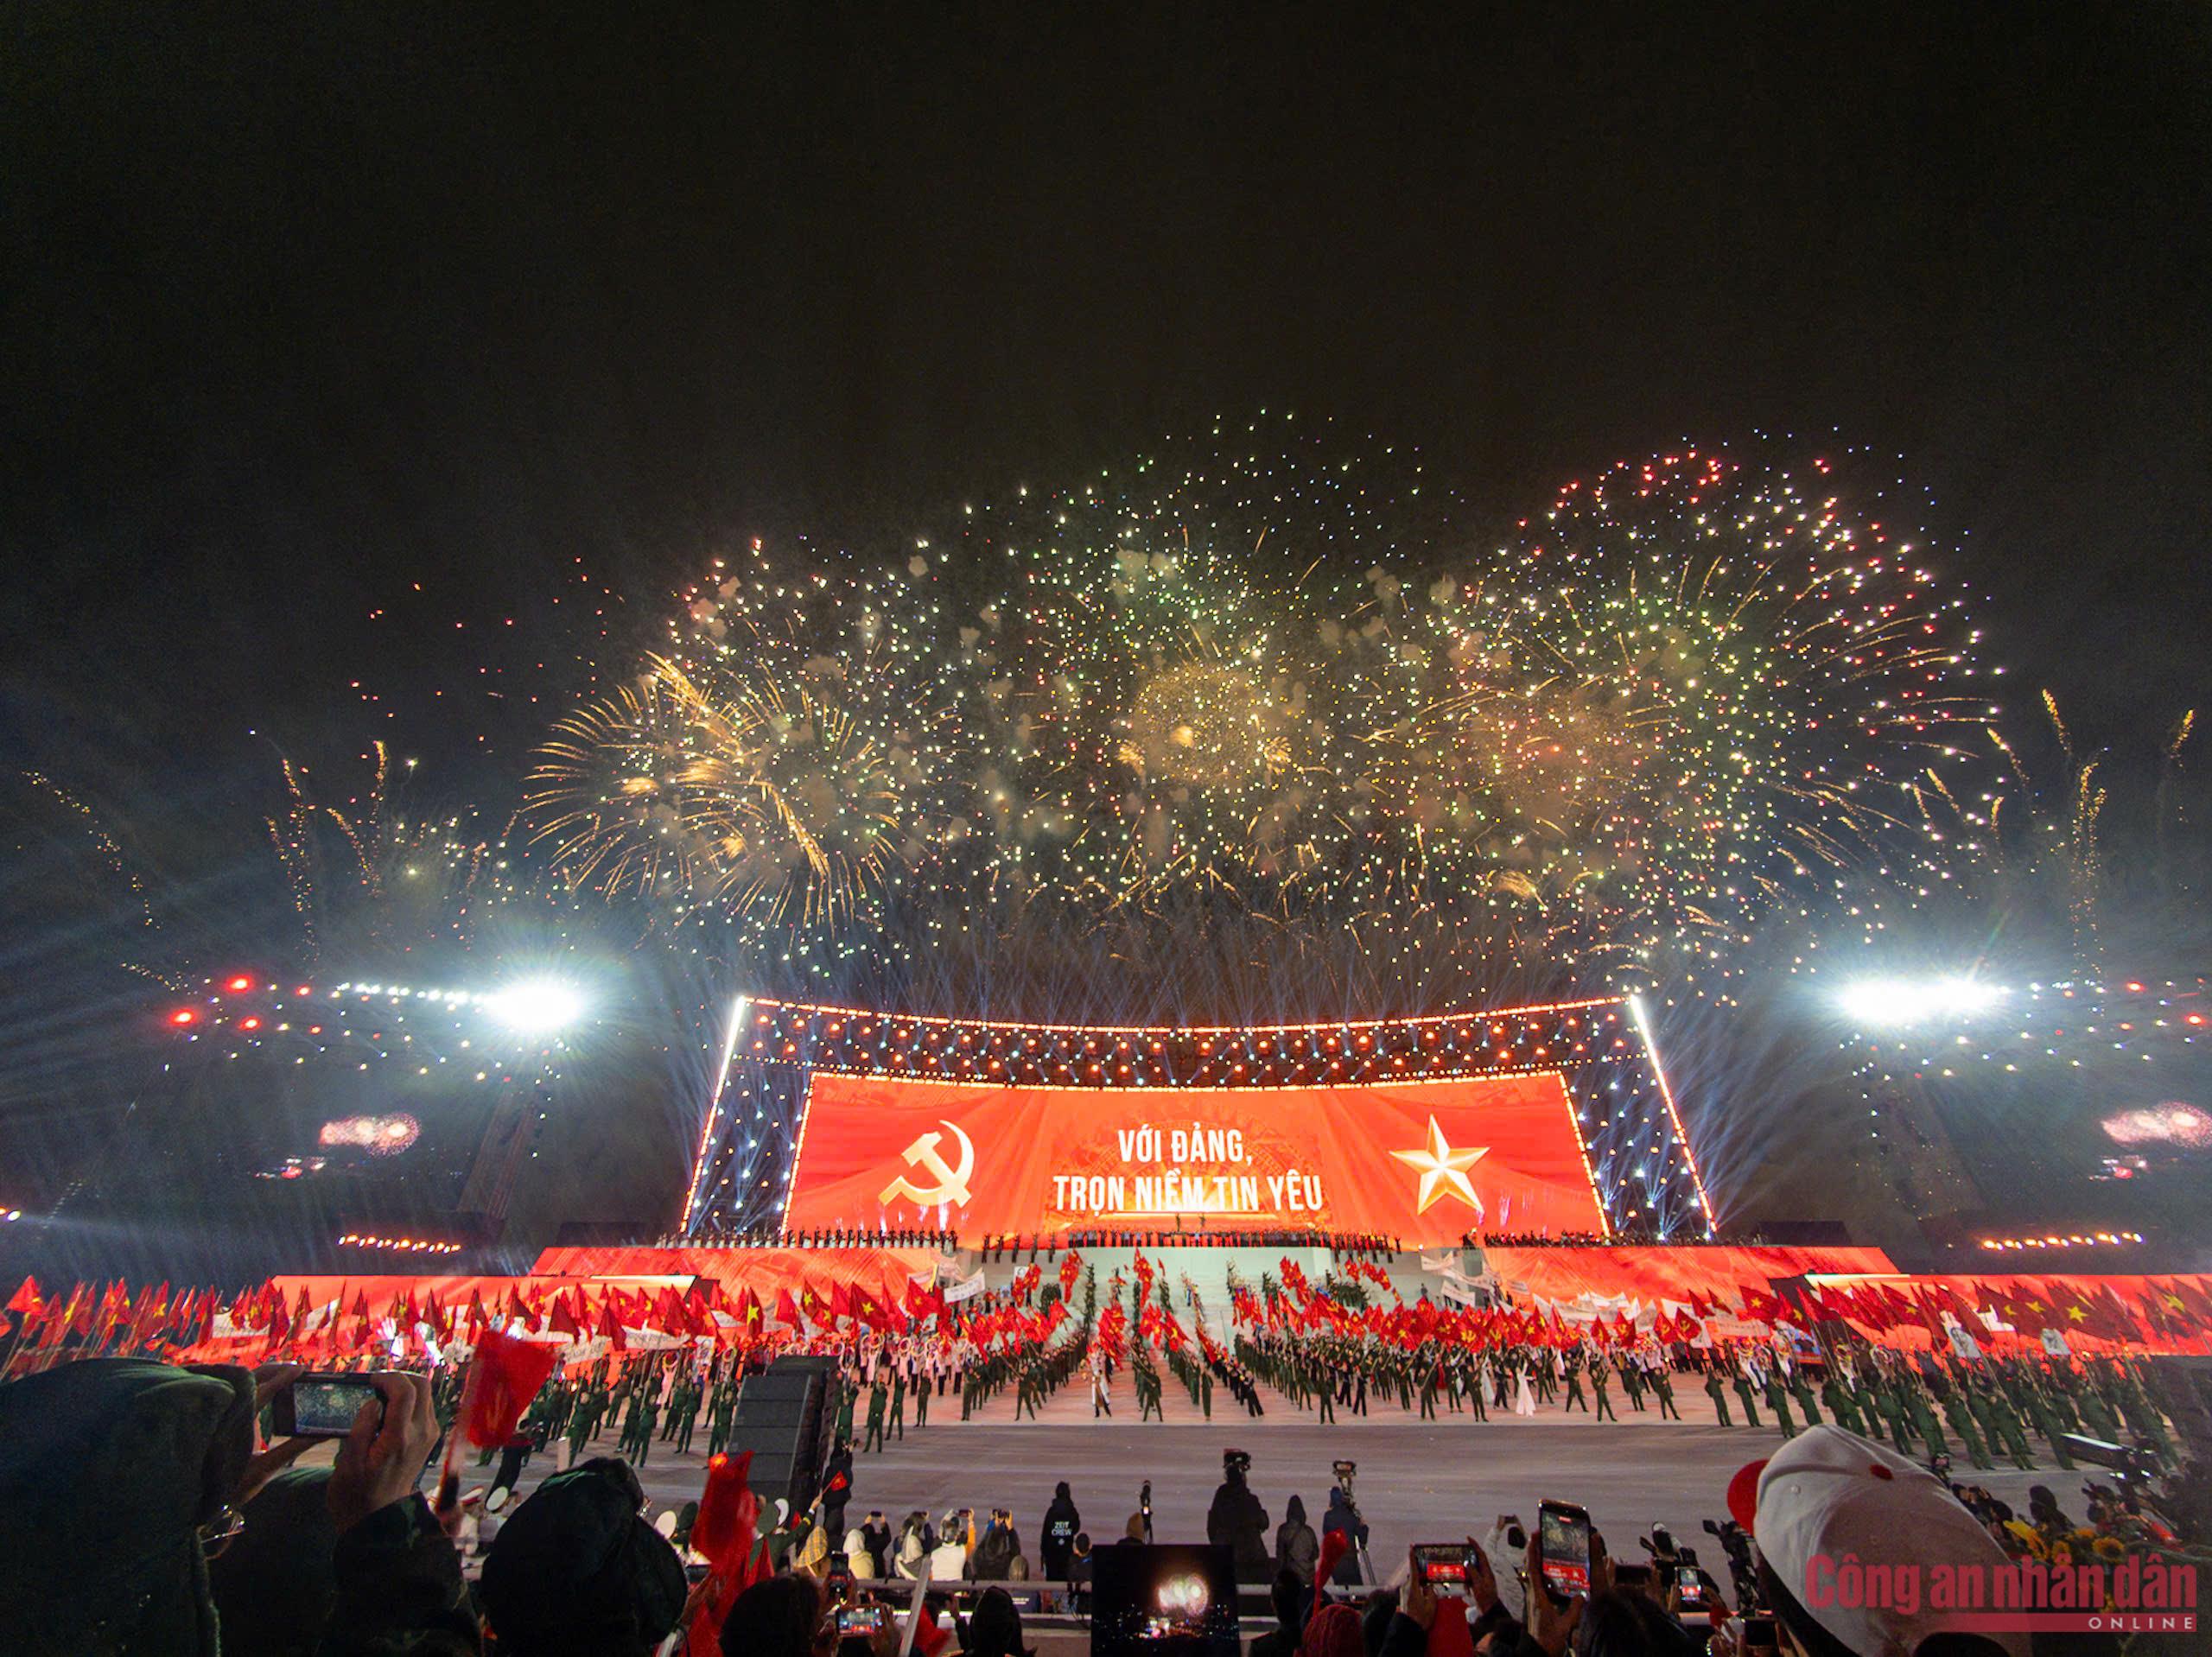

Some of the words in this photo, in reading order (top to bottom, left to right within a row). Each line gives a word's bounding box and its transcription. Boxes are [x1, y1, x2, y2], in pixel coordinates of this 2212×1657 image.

[1118, 1124, 1161, 1163] VỚI
[1171, 1121, 1252, 1165] ĐẢNG,
[1053, 1175, 1124, 1216] TRỌN
[1136, 1168, 1205, 1210] NIỀM
[1212, 1175, 1259, 1210] TIN
[1267, 1169, 1323, 1210] YÊU
